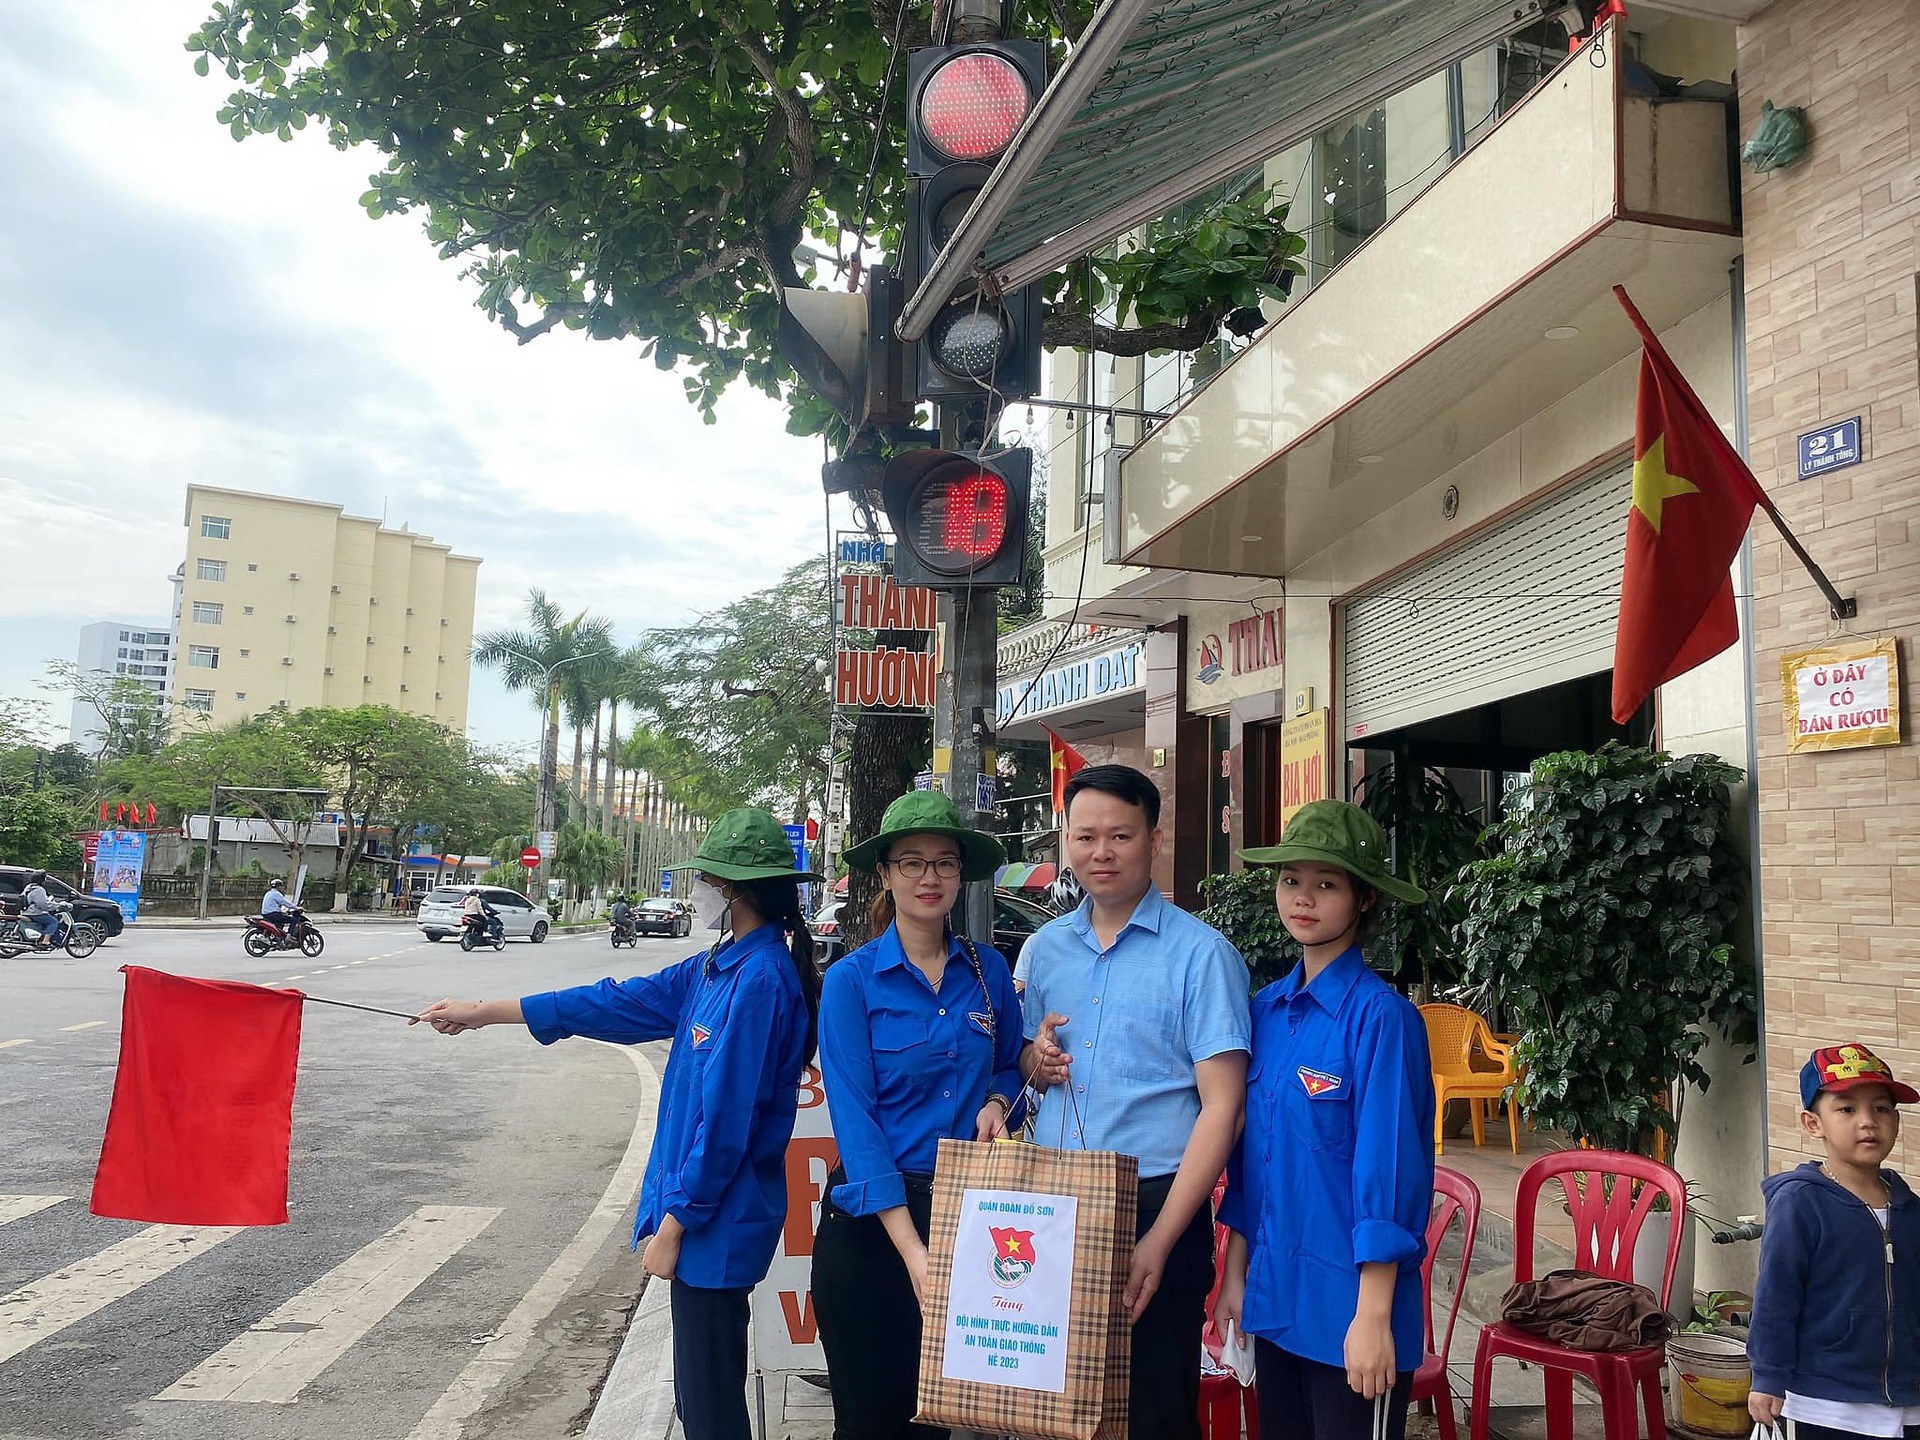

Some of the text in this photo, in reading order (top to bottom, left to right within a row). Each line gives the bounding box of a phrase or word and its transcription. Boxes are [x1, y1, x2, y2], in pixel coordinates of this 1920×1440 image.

[1809, 429, 1848, 457] 21
[1814, 664, 1867, 687] Ở ĐÂY
[1019, 662, 1088, 716] THANH
[1829, 687, 1855, 707] CÓ
[1799, 708, 1888, 734] BÁN RƯỢU
[1284, 750, 1321, 808] BIA HƠI
[978, 1201, 998, 1213] QUẬN
[1037, 1205, 1055, 1217] SƠN
[991, 1296, 1024, 1312] Tặng
[956, 1314, 969, 1330] ĐỘI
[970, 1315, 989, 1330] HÌNH
[991, 1319, 1011, 1334] TRỰC
[1012, 1320, 1039, 1336] HƯỚNG
[964, 1334, 1046, 1355] AN TOÀN GIAO THÔNG
[1000, 1356, 1019, 1369] 2023
